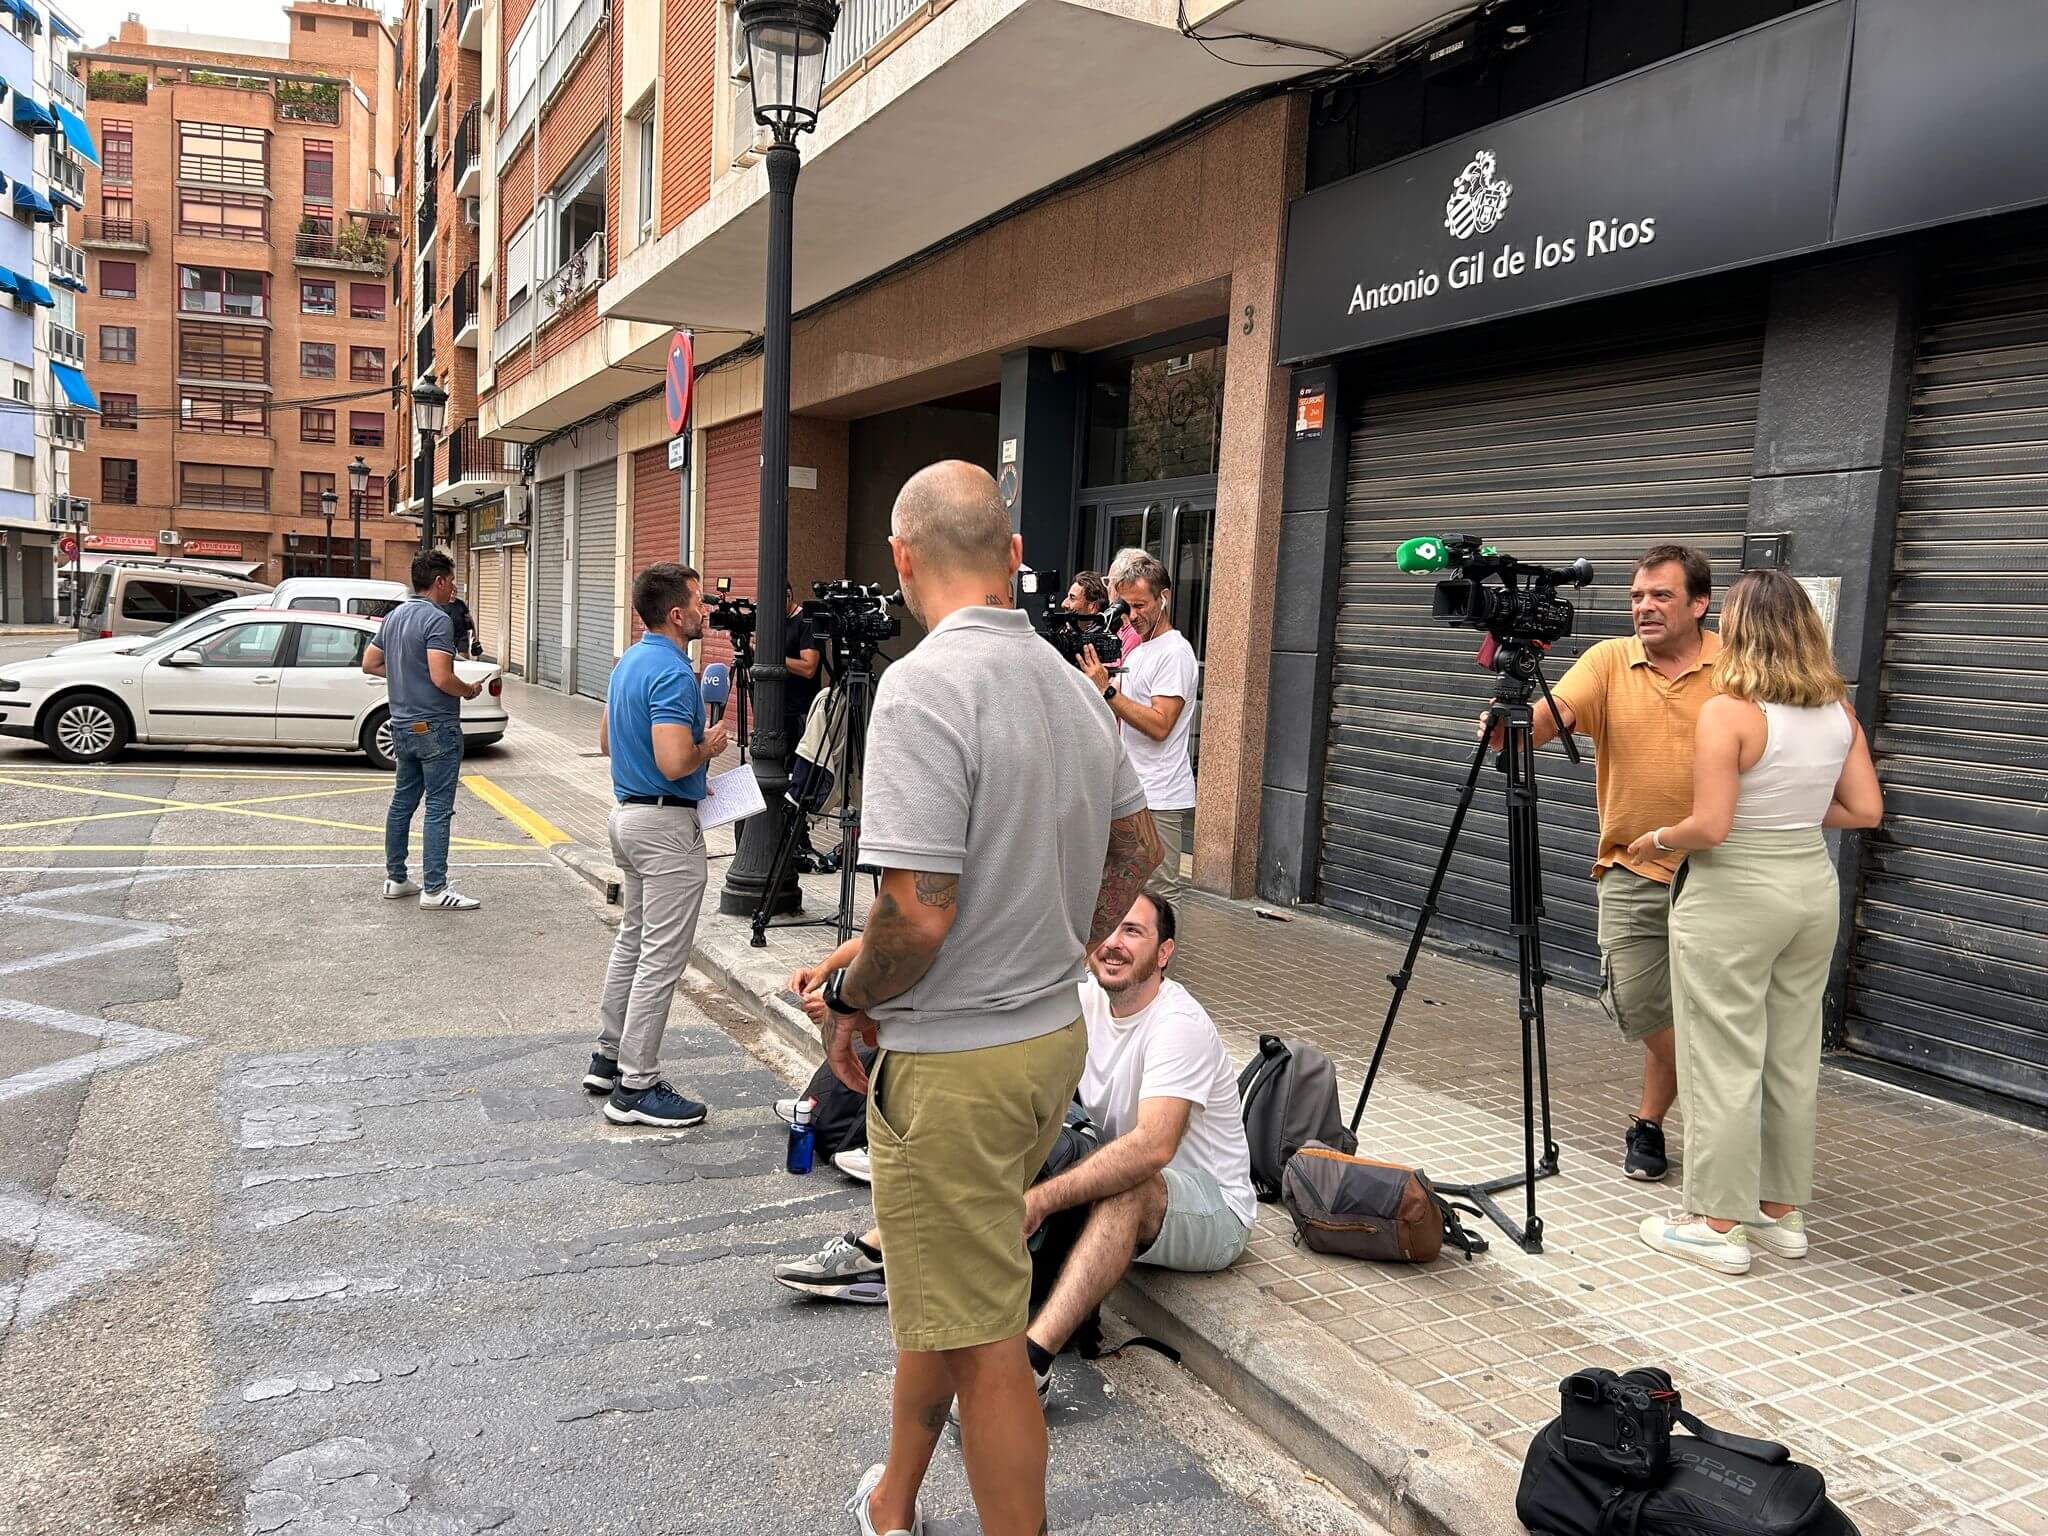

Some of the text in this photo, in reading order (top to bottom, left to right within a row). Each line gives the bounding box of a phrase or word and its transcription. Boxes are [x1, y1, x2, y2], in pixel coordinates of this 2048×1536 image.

[1347, 216, 1657, 315] Antonio Gil de los Rios
[1242, 304, 1255, 336] 3
